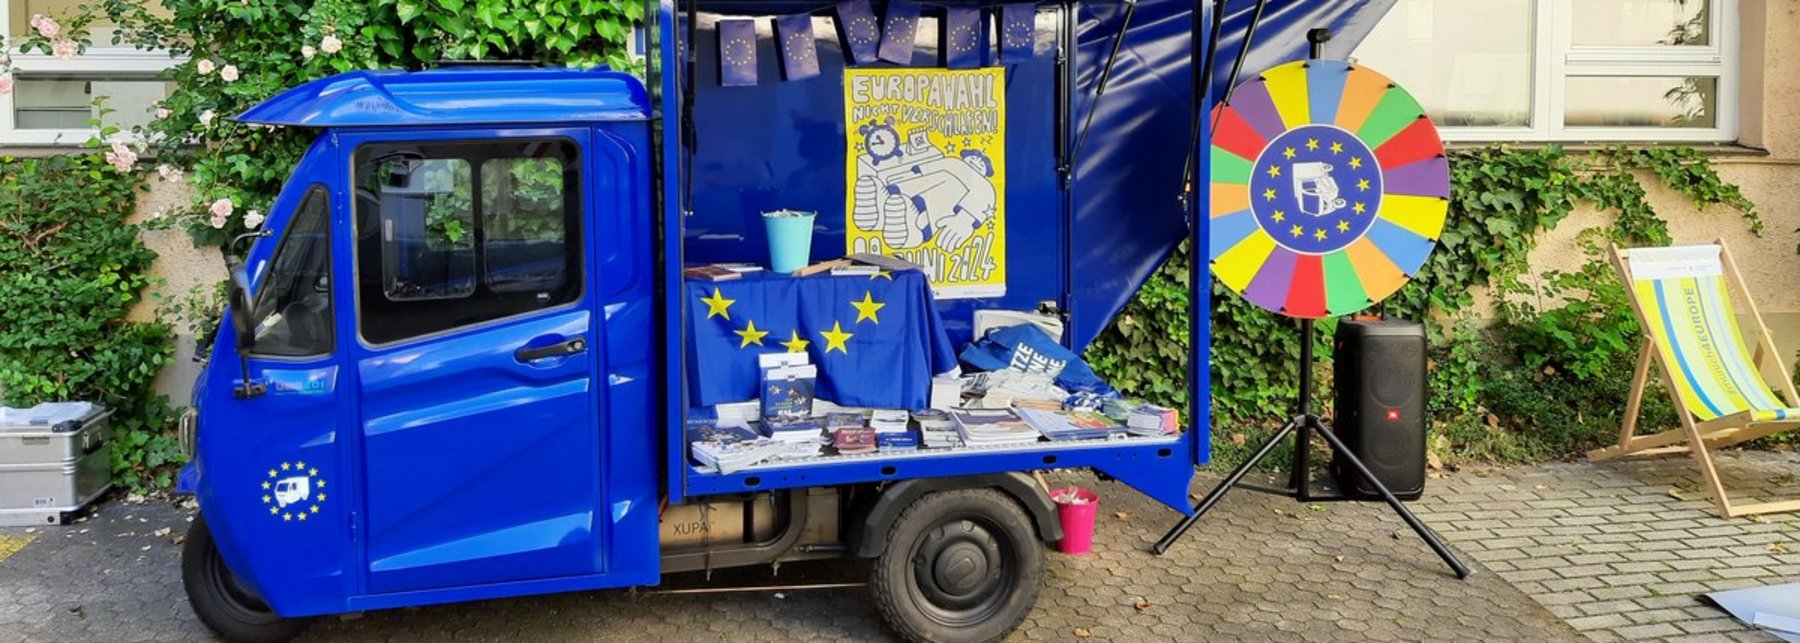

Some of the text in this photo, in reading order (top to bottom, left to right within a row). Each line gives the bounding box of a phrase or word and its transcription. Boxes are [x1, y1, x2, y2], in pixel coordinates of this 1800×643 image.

[852, 74, 997, 110] EUROPAWAHL
[852, 104, 900, 123] NICHT
[1010, 342, 1034, 368] TZE
